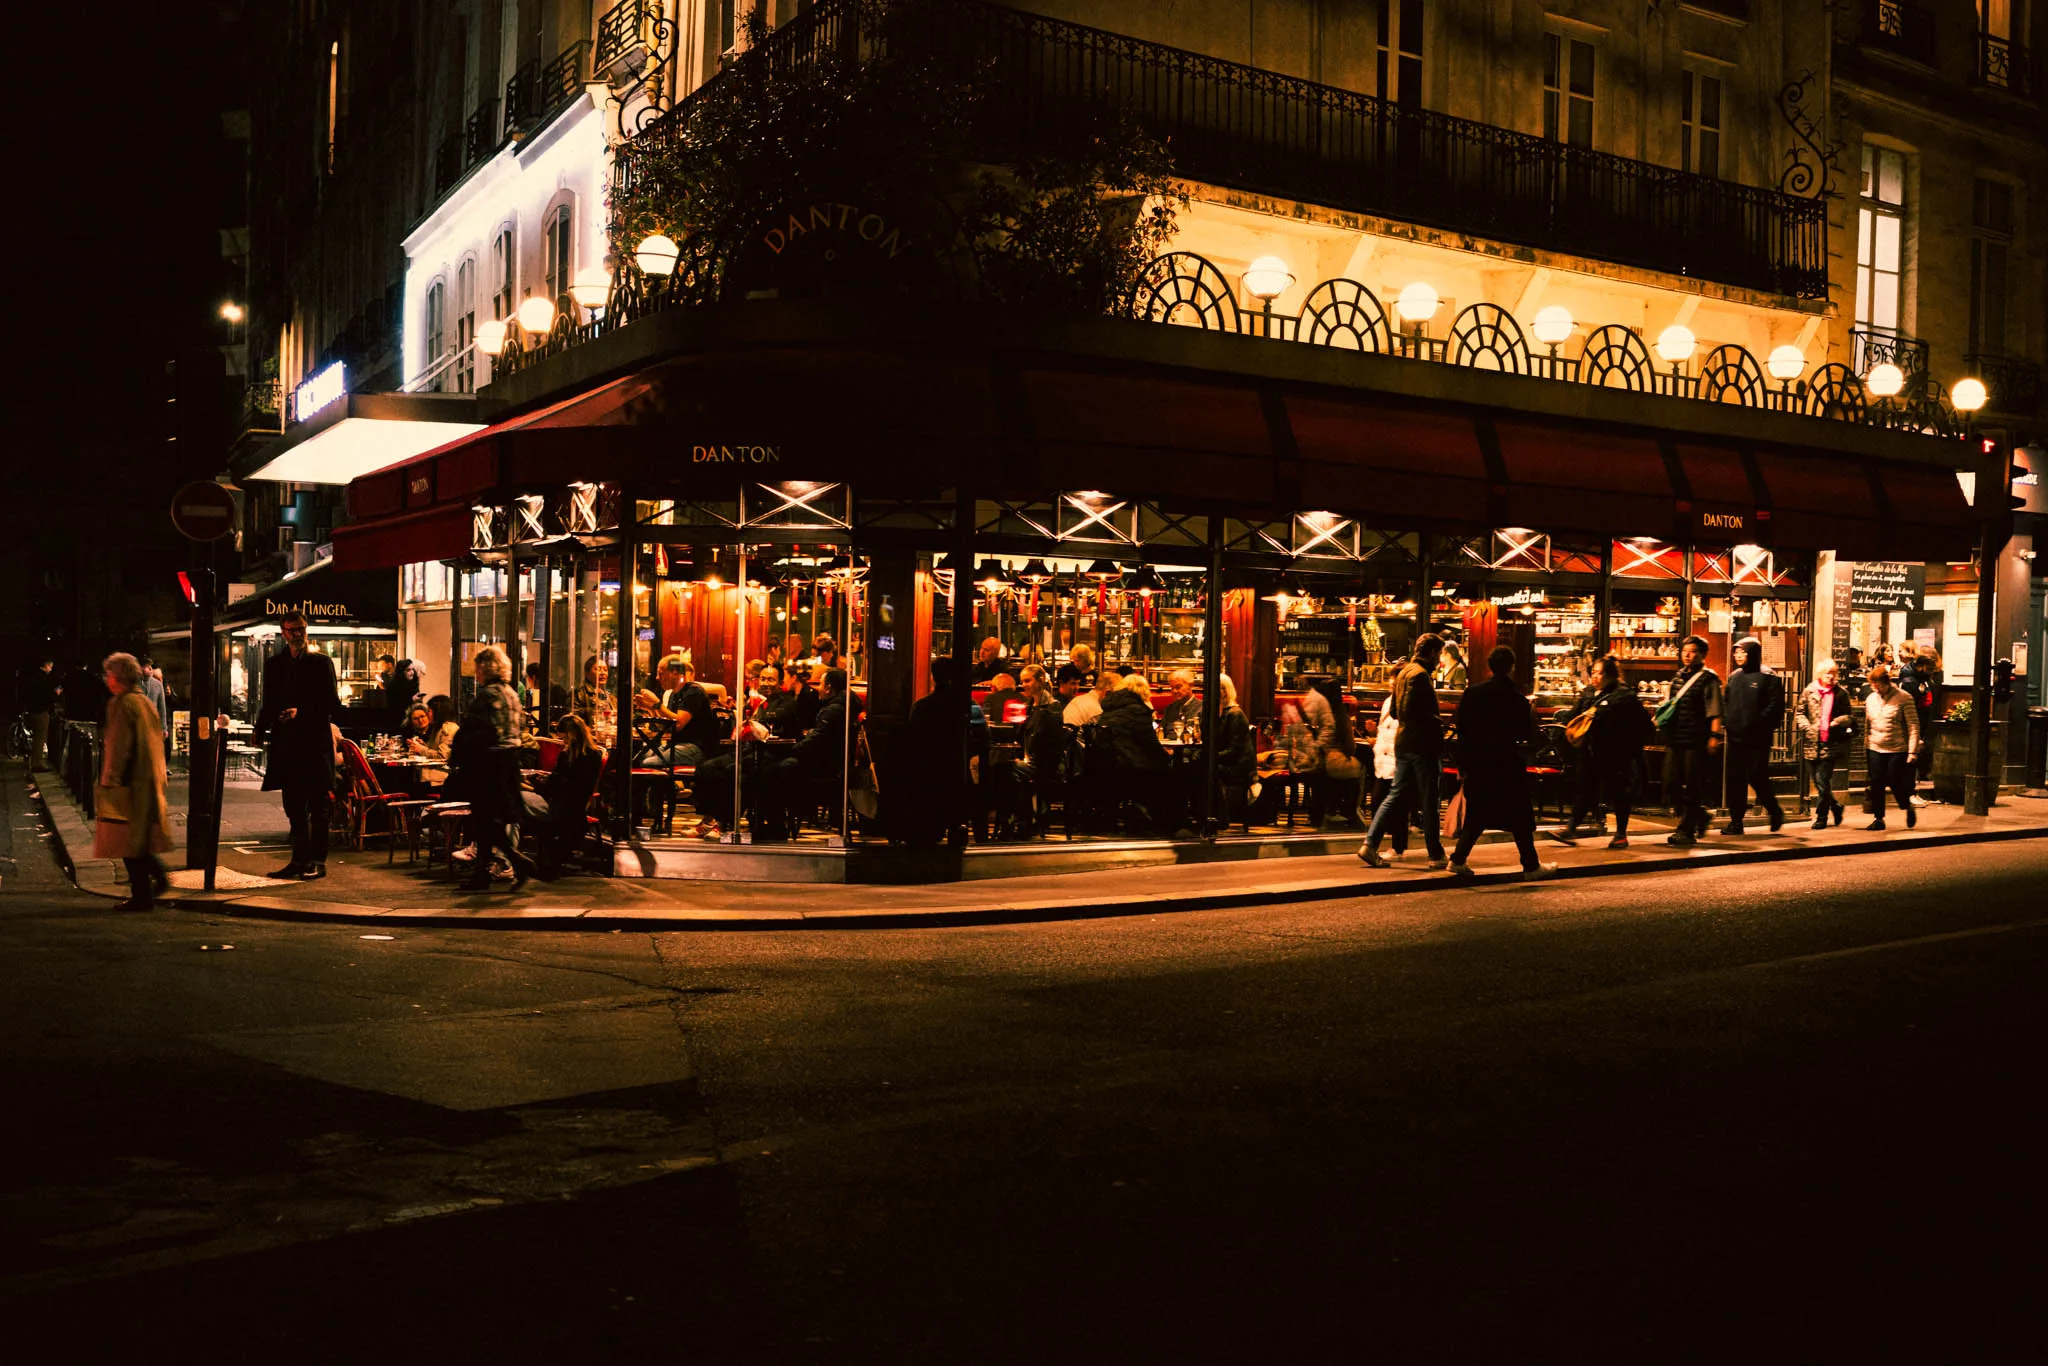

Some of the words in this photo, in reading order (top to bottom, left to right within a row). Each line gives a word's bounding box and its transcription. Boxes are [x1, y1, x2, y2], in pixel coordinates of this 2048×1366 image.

[763, 202, 912, 260] DANTON
[693, 445, 780, 463] DANTON
[1703, 512, 1744, 529] DANTON
